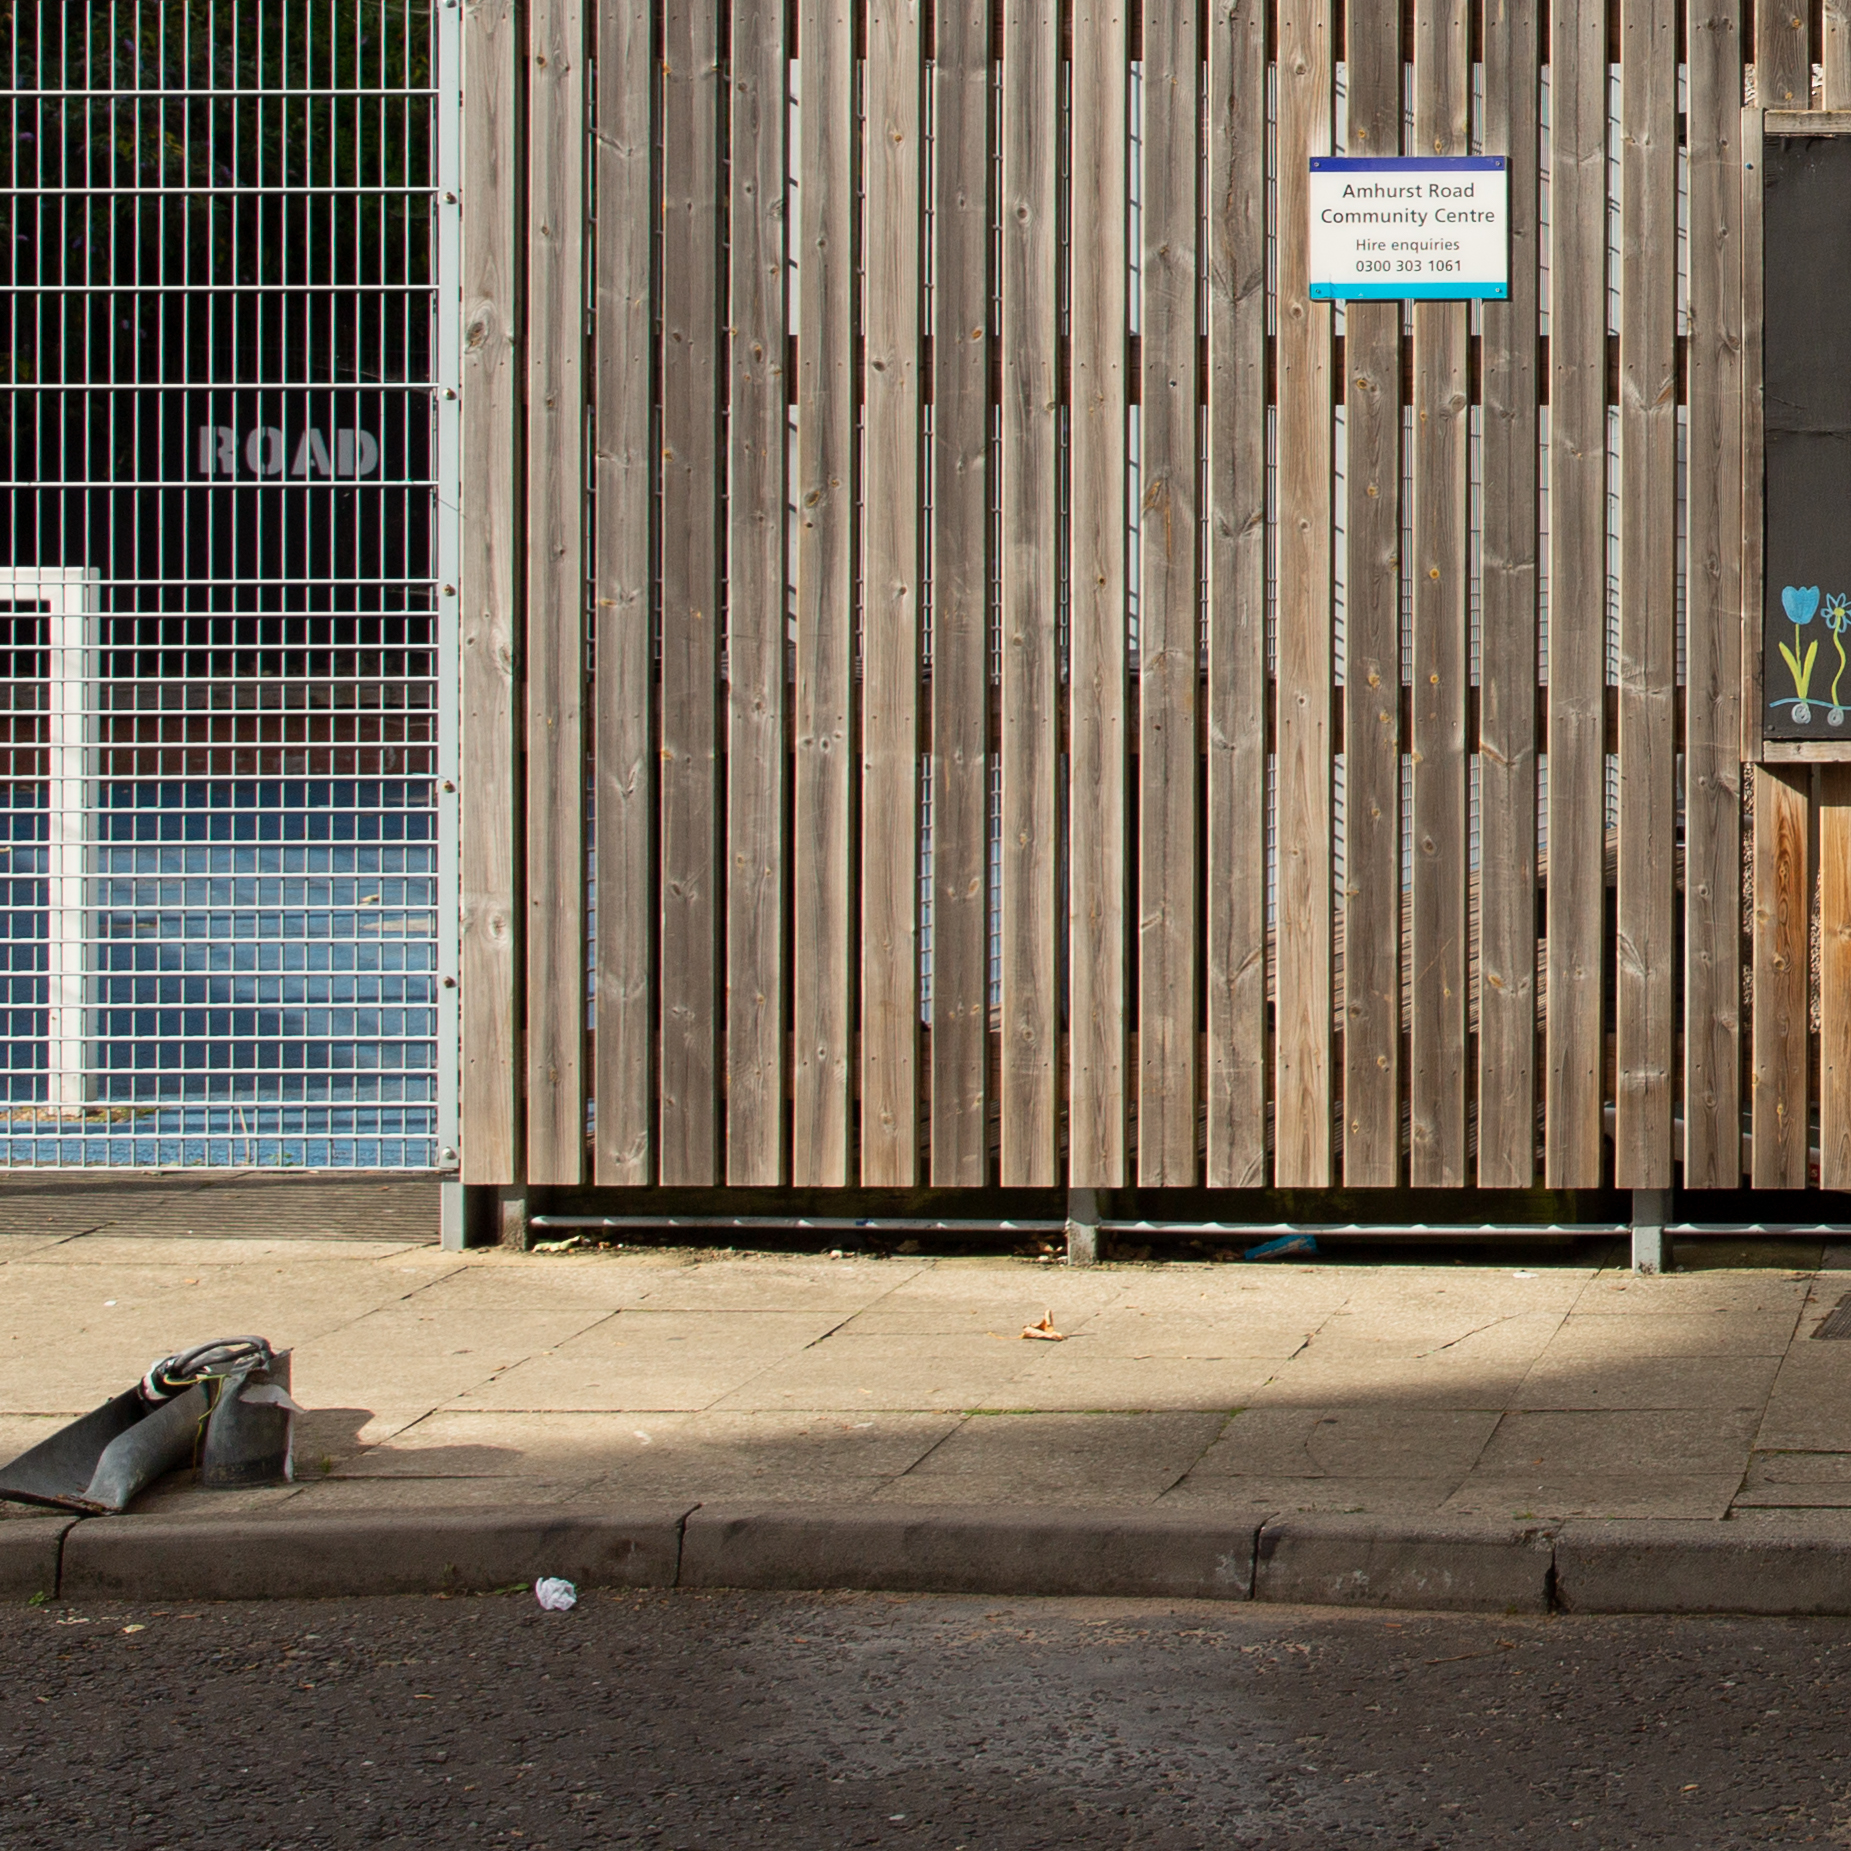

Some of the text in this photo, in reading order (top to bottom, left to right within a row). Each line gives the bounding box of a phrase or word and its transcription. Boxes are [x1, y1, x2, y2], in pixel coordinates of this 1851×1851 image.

[1342, 182, 1475, 198] Amhurst Road
[1321, 207, 1495, 227] Community Centre
[1356, 238, 1460, 254] Hire enquiries
[1355, 259, 1462, 272] 0300 303 1061
[200, 426, 378, 476] ROAD
